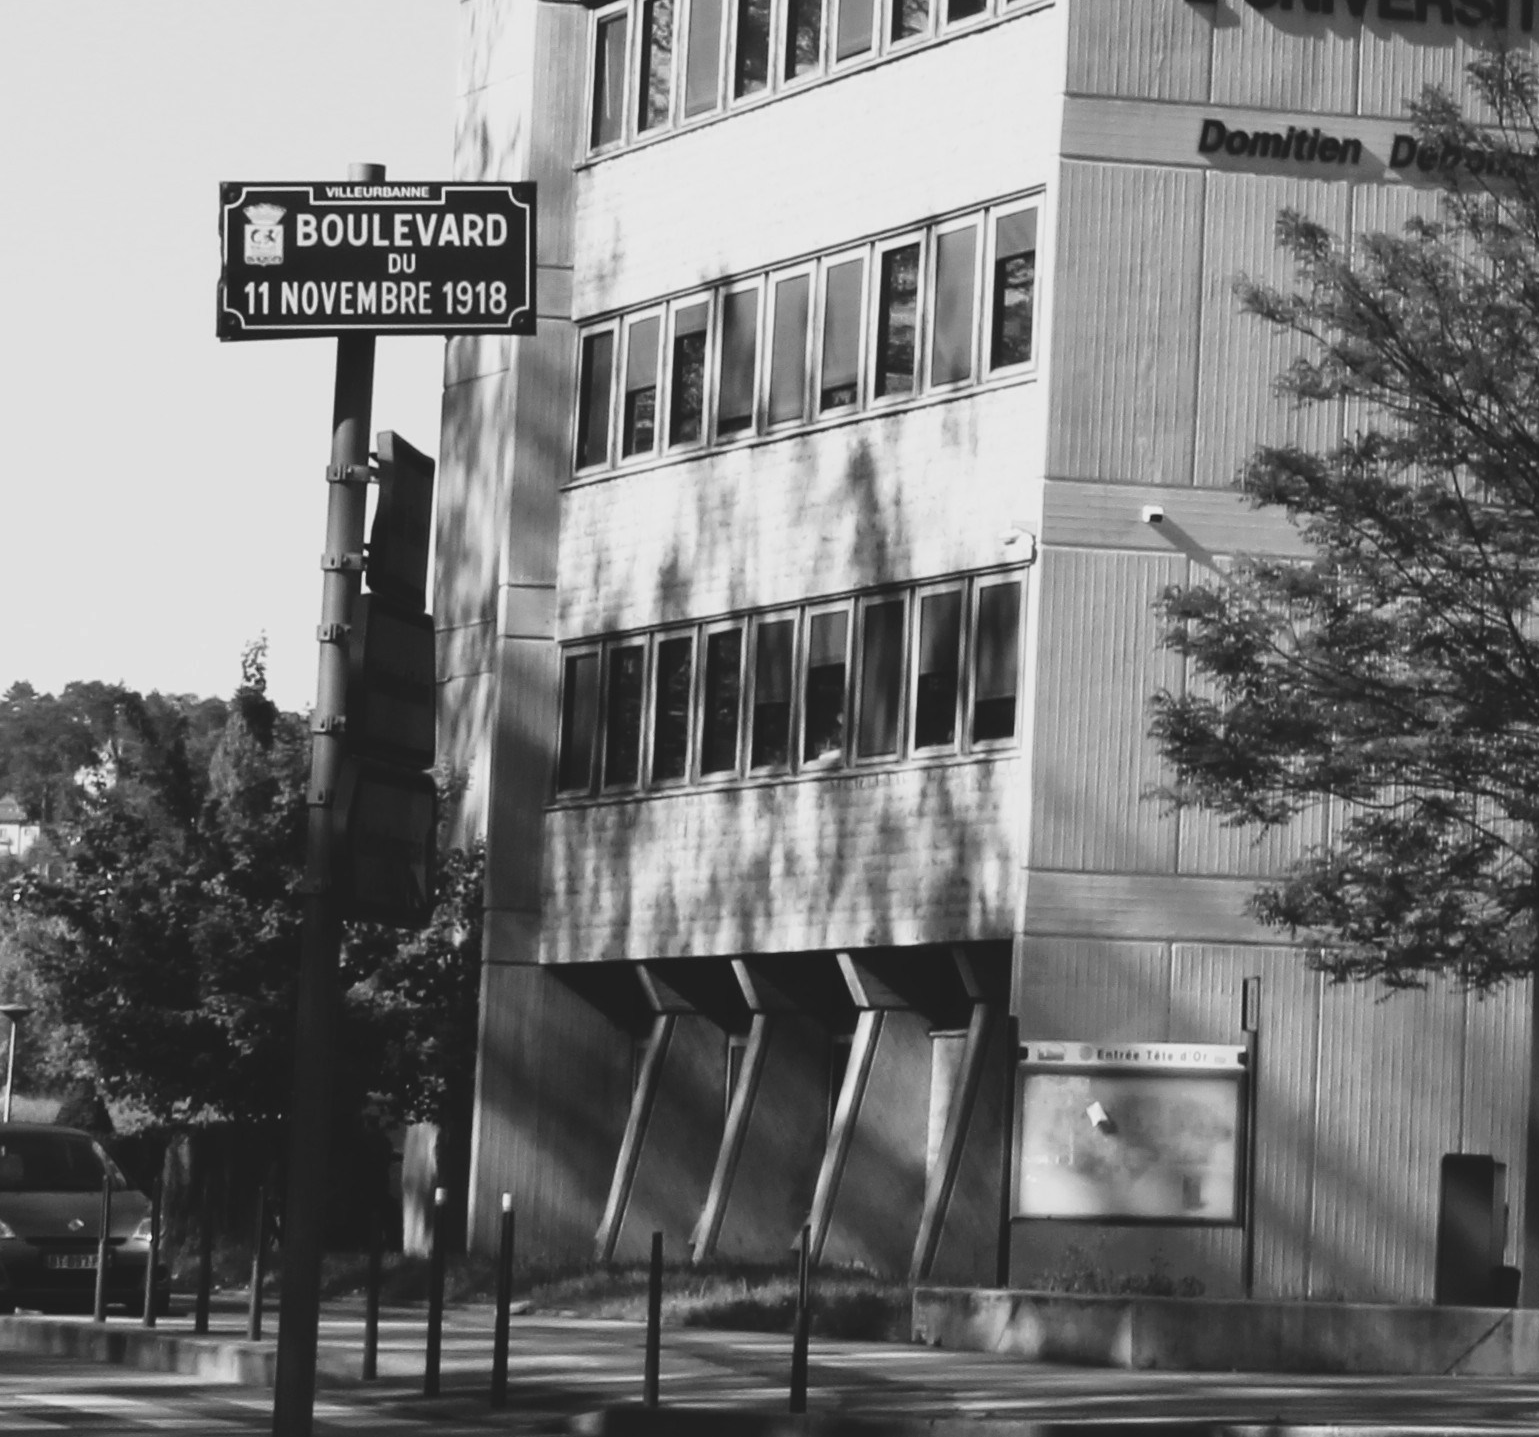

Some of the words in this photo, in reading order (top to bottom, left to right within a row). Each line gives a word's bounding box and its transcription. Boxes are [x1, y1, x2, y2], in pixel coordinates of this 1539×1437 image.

[1199, 118, 1362, 165] Domitien
[326, 186, 430, 199] VILLEURBANNE
[296, 213, 508, 247] BOULEVARD
[387, 253, 416, 274] DU
[243, 281, 270, 315] 11
[280, 281, 432, 315] NOVEMBRE
[442, 281, 508, 315] 1918
